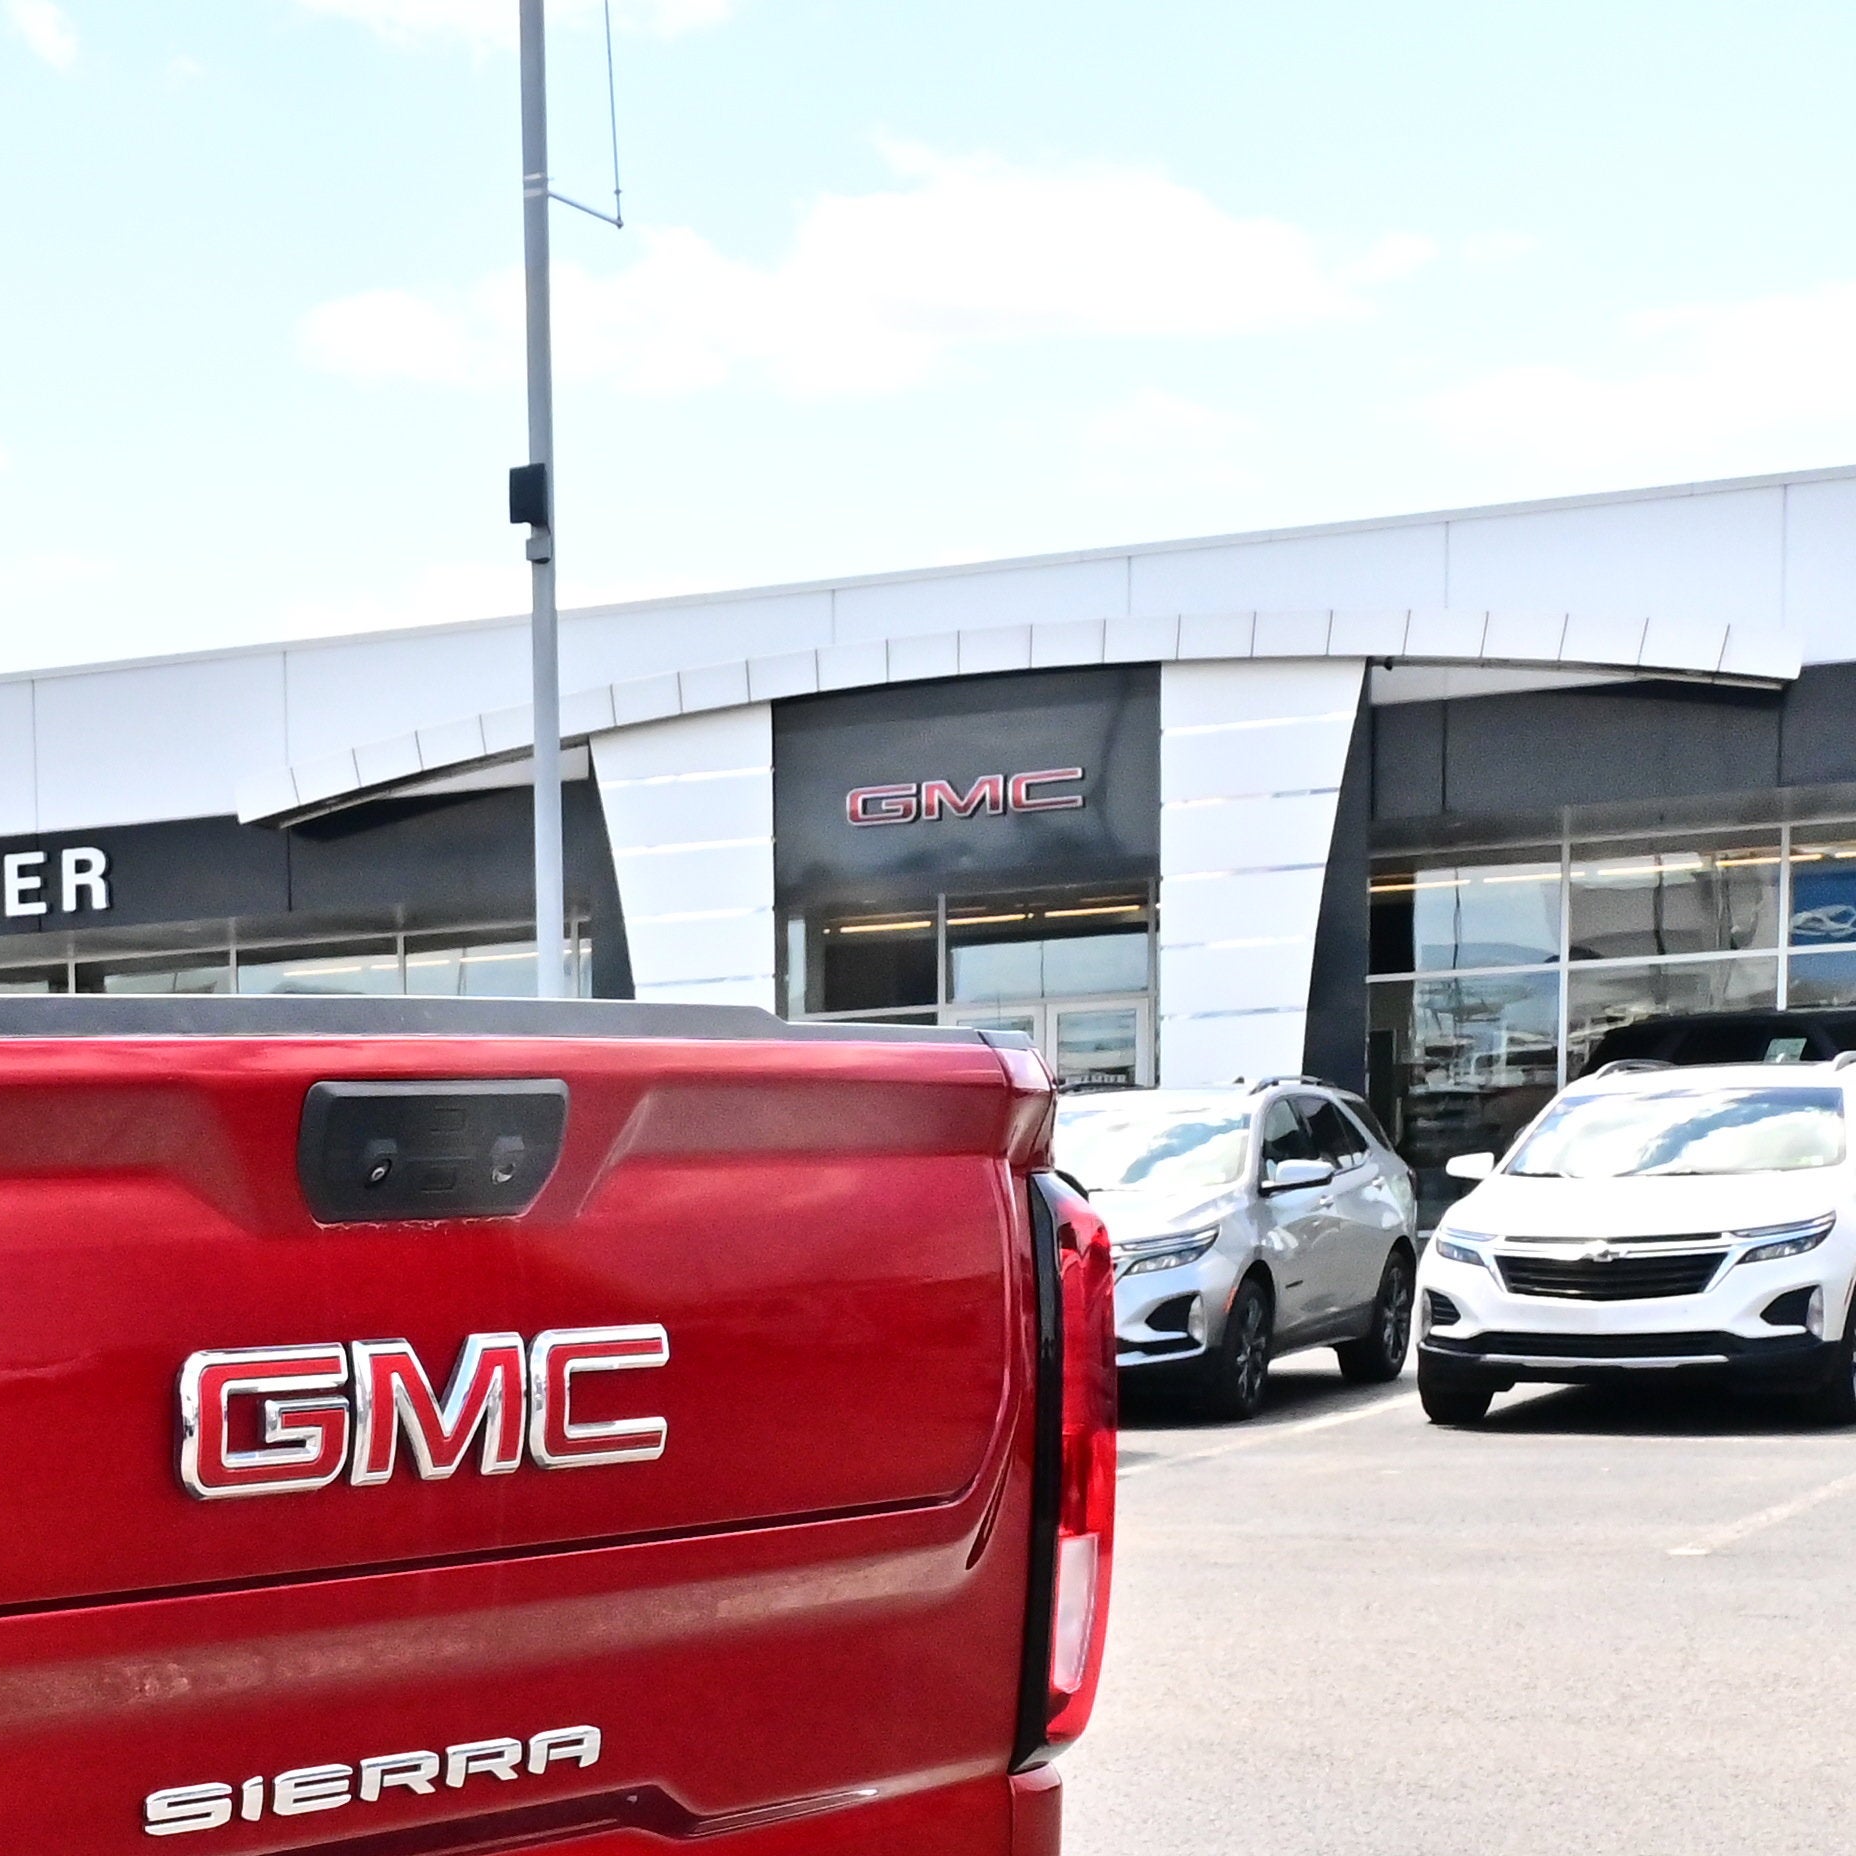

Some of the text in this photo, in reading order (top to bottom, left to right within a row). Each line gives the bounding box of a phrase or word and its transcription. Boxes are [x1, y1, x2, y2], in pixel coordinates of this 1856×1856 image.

[845, 766, 1086, 828] GMC
[180, 1323, 670, 1500] GMC
[143, 1725, 602, 1836] SIERRA
